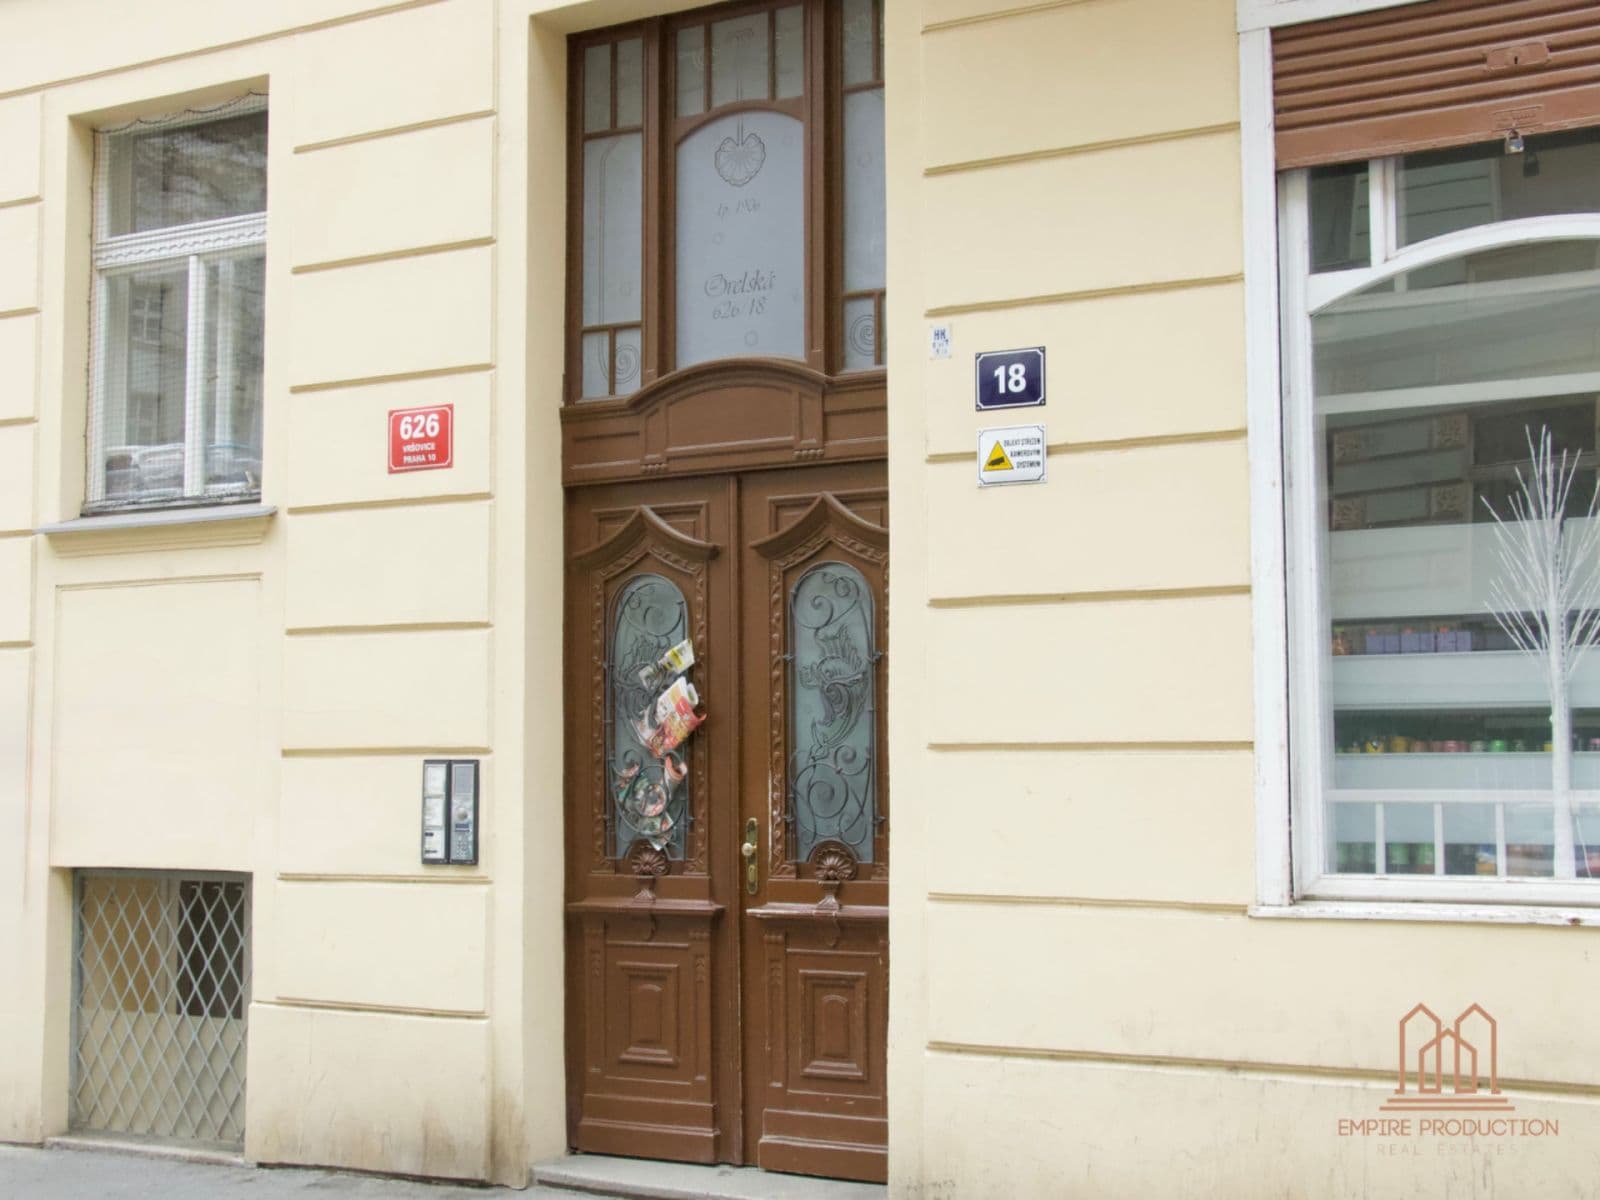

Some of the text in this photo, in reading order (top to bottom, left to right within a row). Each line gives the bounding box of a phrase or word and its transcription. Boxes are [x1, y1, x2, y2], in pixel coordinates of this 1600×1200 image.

[993, 363, 1027, 394] 18
[400, 413, 440, 440] 626
[403, 453, 437, 464] PRAHA 10
